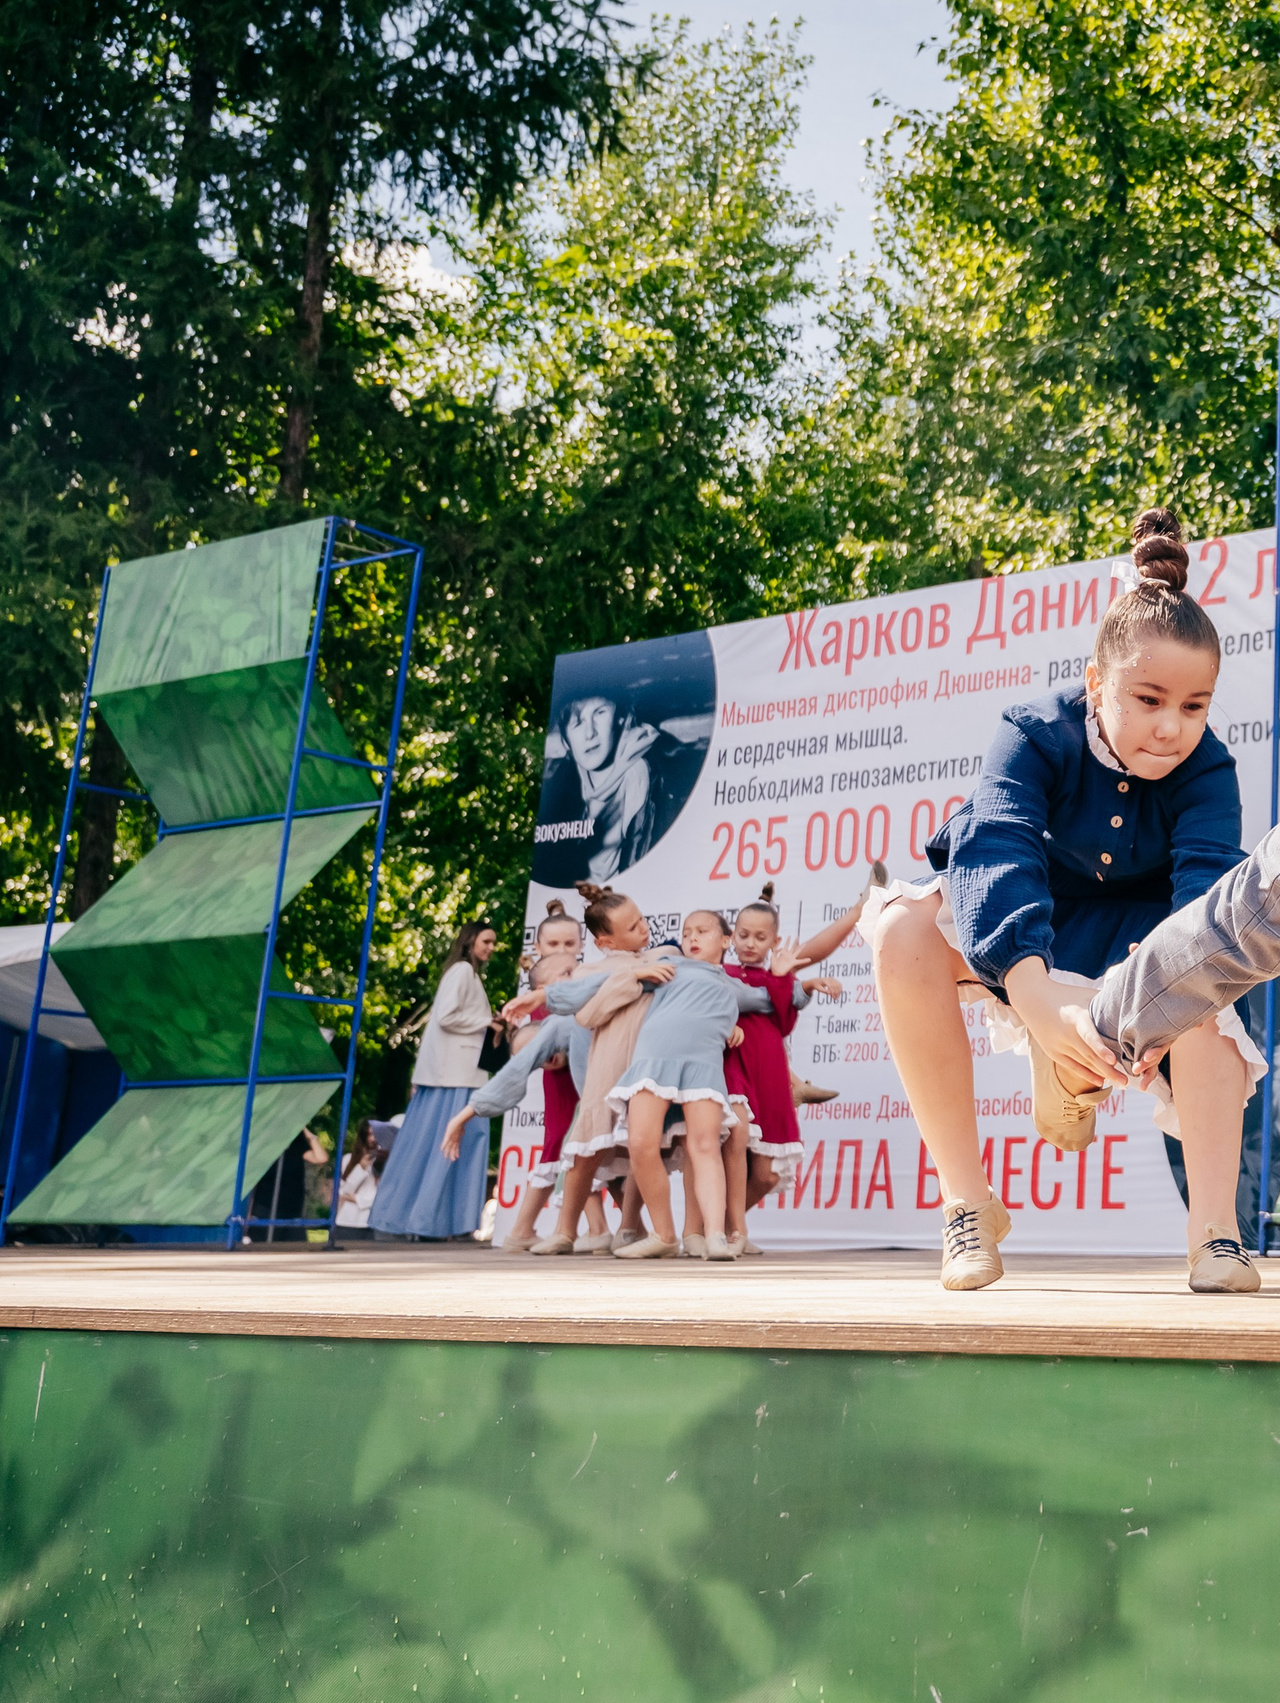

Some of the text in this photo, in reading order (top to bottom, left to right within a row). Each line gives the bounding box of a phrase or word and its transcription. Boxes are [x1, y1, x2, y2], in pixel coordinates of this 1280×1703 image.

[777, 602, 951, 676] Жарков
[966, 574, 1121, 655] Дани
[721, 694, 818, 728] Мышечная
[823, 677, 927, 717] дистрофия
[717, 723, 908, 768] и сердечная мышца.
[713, 771, 824, 806] Необходима
[708, 814, 788, 881] 265
[804, 804, 891, 871] 000
[819, 959, 872, 978] Наталья
[815, 1015, 861, 1035] Т-банк:
[812, 1043, 841, 1063] ВТБ:
[844, 1041, 879, 1062] 2200
[805, 1100, 871, 1122] лечение
[876, 1095, 916, 1123] Дан
